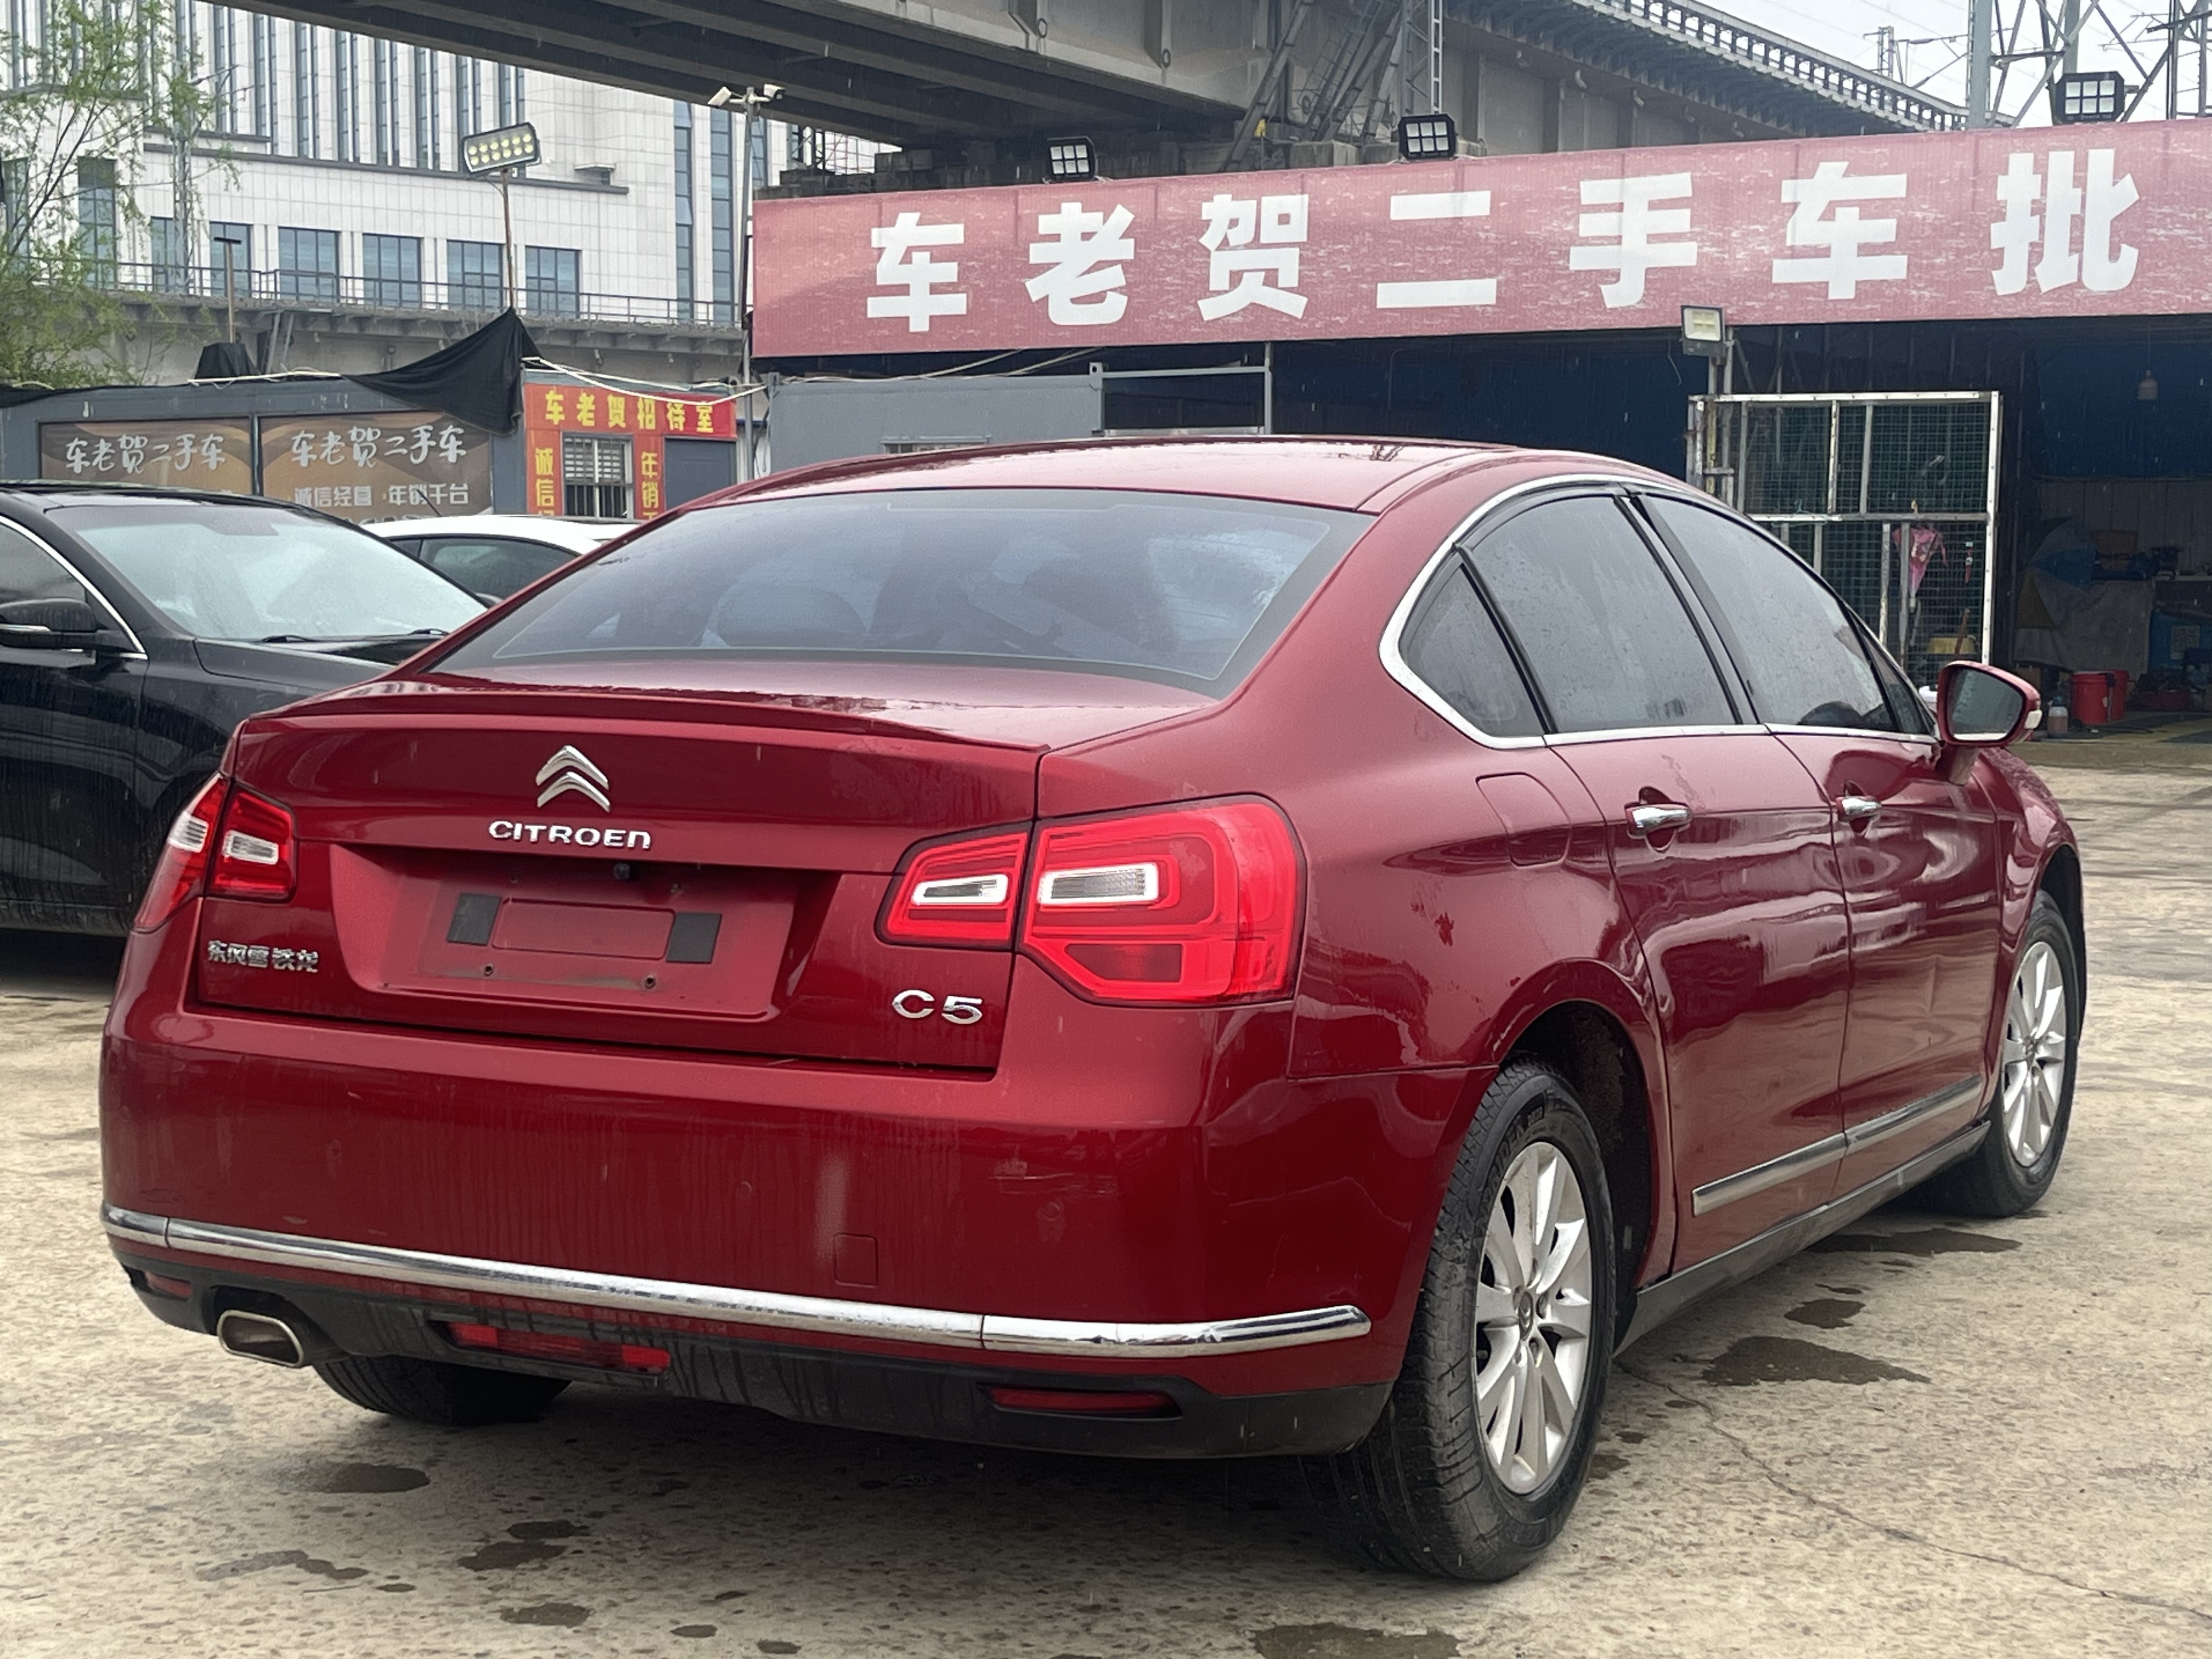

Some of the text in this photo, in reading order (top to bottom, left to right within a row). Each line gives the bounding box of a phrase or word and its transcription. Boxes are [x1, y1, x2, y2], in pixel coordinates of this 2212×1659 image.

[866, 148, 2140, 334] 车老贺二手车批
[544, 389, 714, 433] 车老贺招待室
[65, 433, 226, 474] 车老贺二手车
[291, 425, 466, 467] 车老贺二手车
[534, 447, 555, 516] 诚信
[891, 989, 983, 1024] C5
